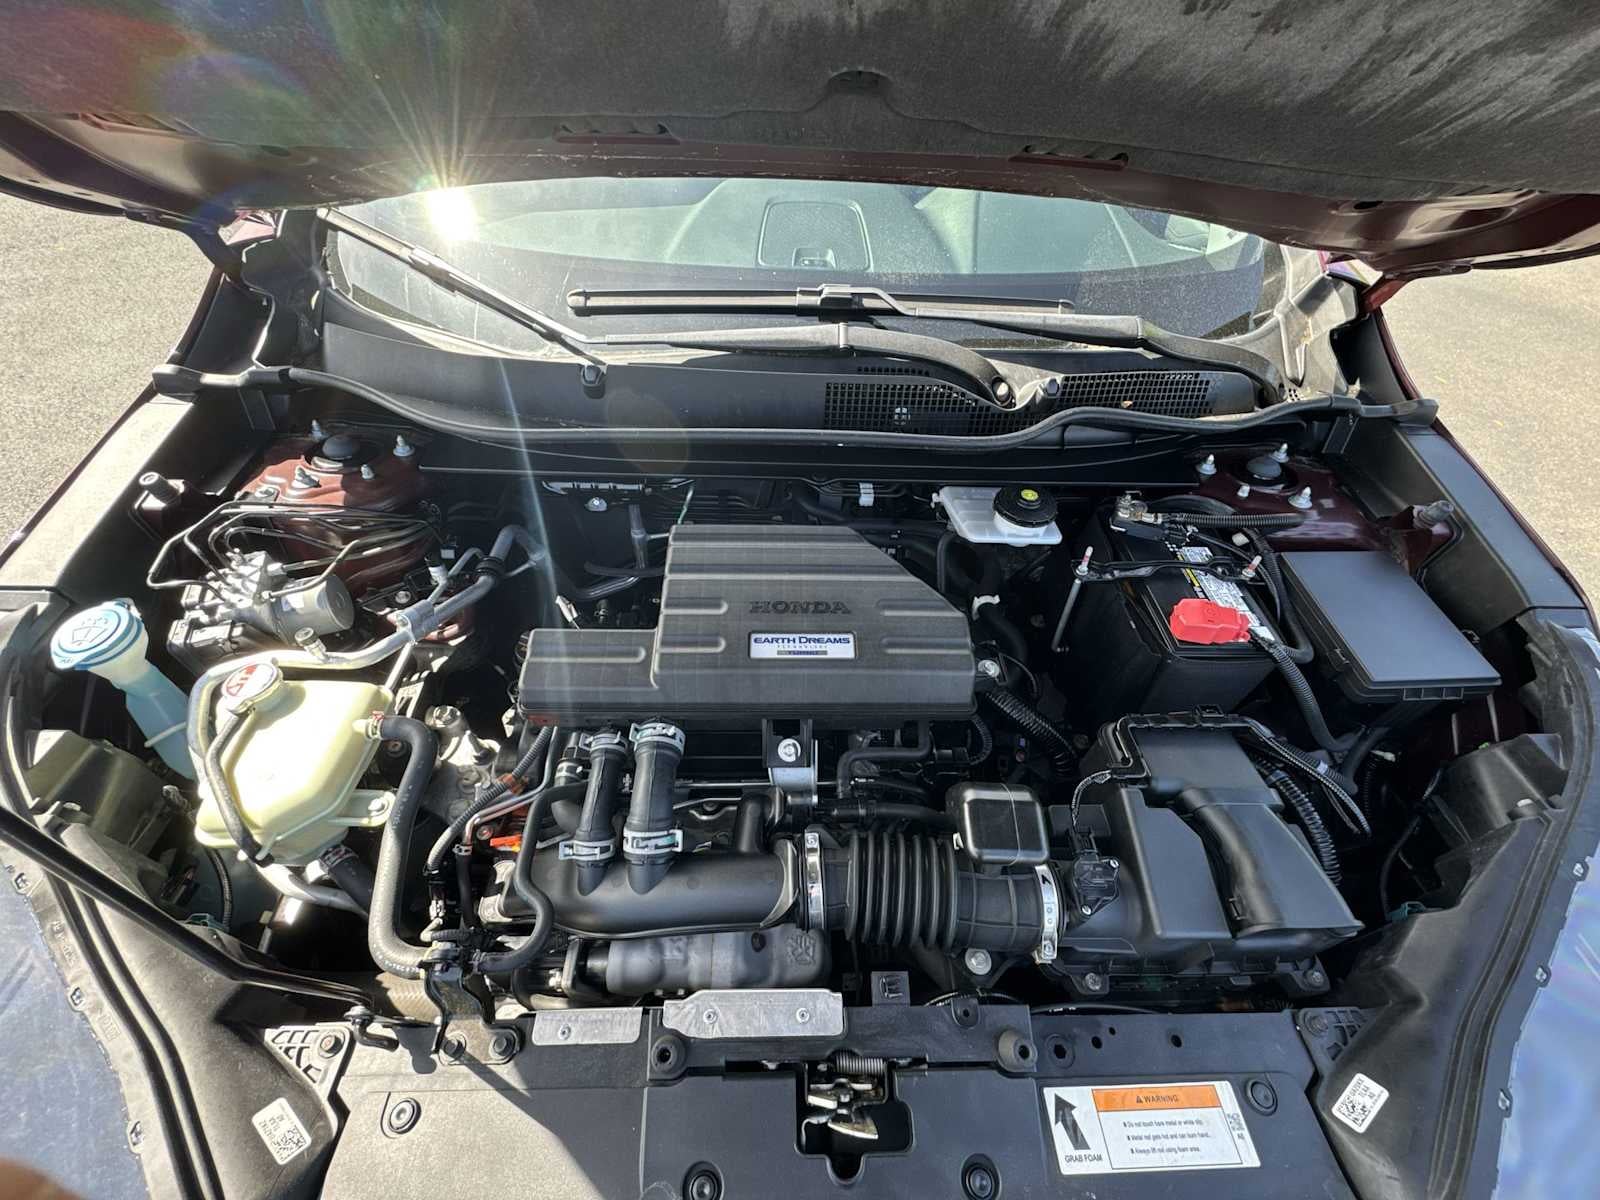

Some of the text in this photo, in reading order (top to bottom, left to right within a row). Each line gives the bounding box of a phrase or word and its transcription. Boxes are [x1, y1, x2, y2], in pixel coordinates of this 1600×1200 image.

[749, 600, 852, 615] HONDA
[753, 636, 850, 644] EARTH DREAMS
[1144, 1094, 1179, 1104] WARNING
[1064, 1153, 1103, 1163] GRAB FOAM
